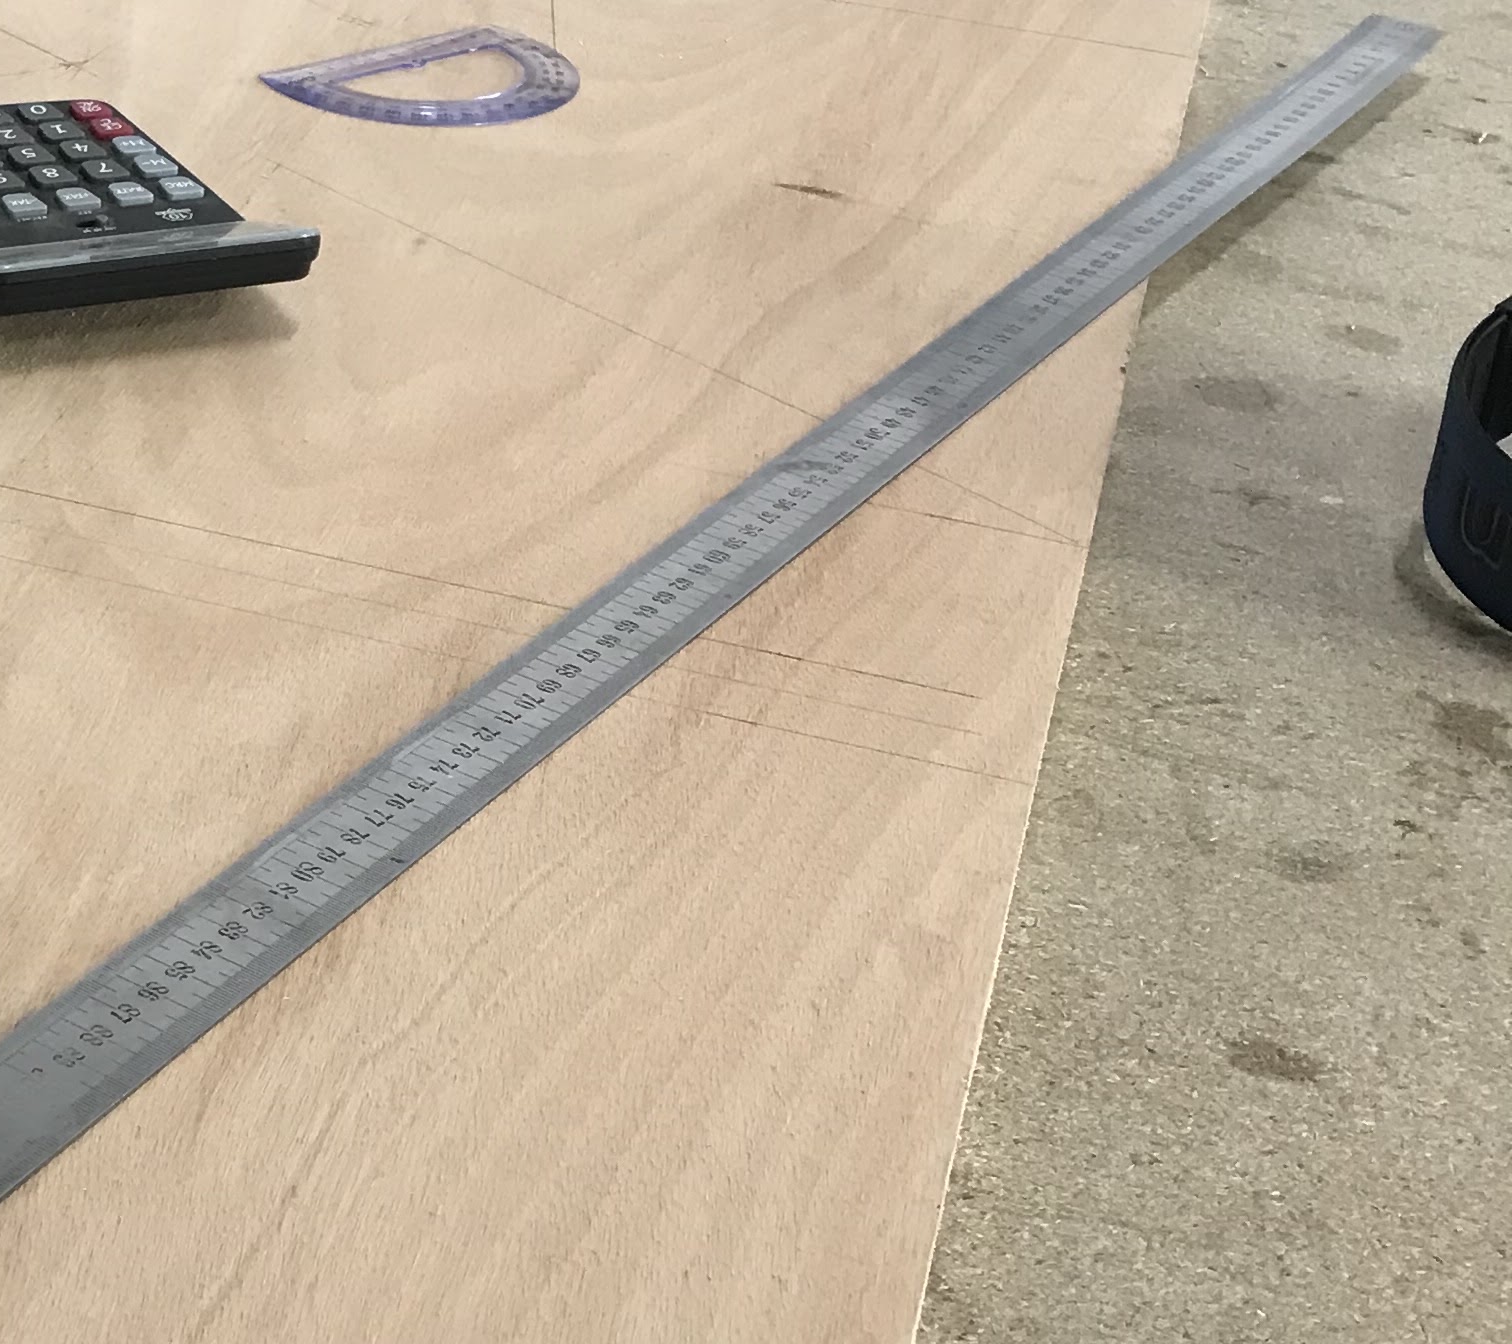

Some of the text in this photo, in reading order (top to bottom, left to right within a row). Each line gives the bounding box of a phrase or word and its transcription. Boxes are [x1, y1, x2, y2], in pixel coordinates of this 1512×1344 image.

[30, 105, 47, 115] 0
[50, 124, 67, 134] 1
[21, 148, 37, 159] 5
[72, 142, 88, 152] 4
[42, 167, 59, 178] 8
[99, 162, 113, 173] 7
[513, 692, 544, 709] 70
[493, 709, 521, 724] 71
[471, 725, 501, 742] 72
[450, 741, 479, 758] 73
[428, 757, 459, 775] 74
[406, 775, 436, 791] 75
[383, 792, 414, 808] 76
[362, 808, 393, 825] 77
[338, 826, 370, 844] 78
[315, 845, 346, 862] 79
[289, 862, 324, 881] 80
[241, 902, 273, 920] 82
[216, 921, 249, 941] 83
[190, 941, 223, 960] 84
[162, 961, 196, 981] 85
[135, 982, 168, 1002] 86
[107, 1003, 141, 1023] 87
